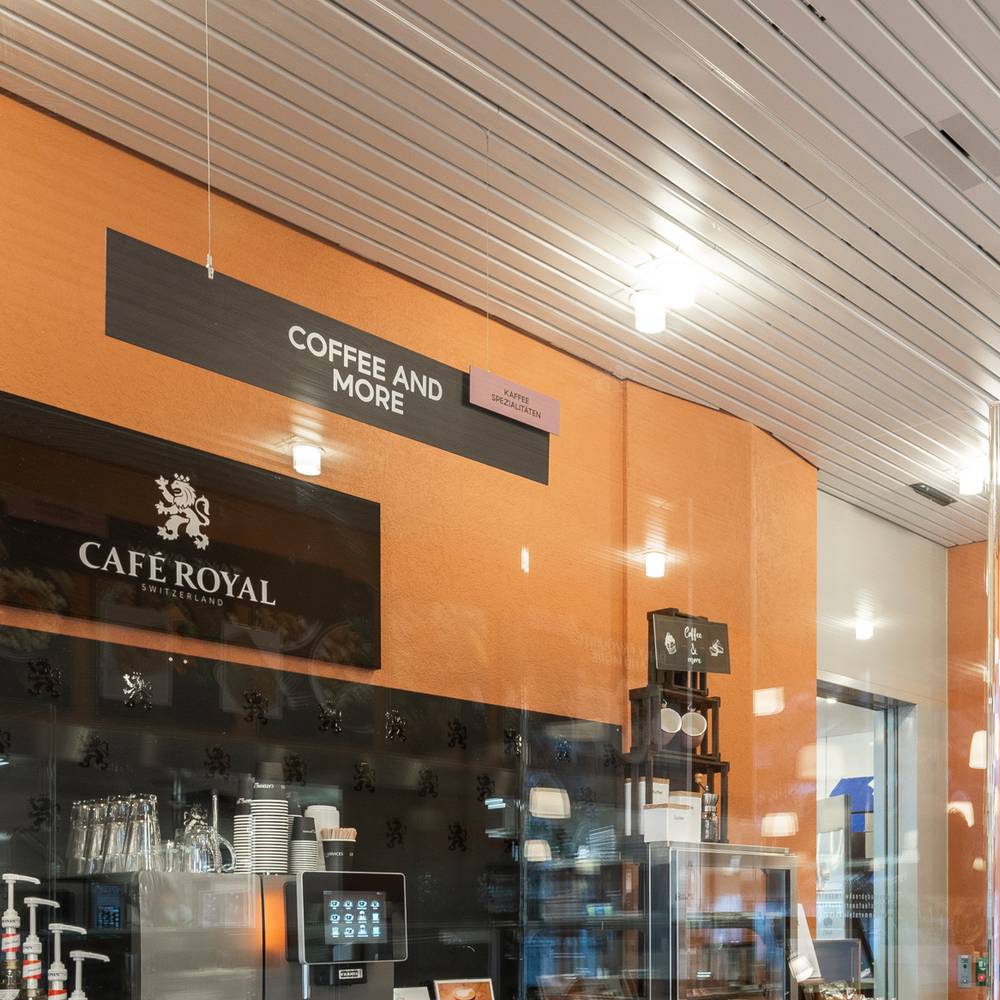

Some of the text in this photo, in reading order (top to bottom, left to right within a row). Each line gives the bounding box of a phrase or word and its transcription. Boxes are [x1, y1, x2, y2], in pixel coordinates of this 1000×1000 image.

[288, 325, 443, 401] COFFEE AND
[332, 368, 404, 415] MORE
[503, 388, 530, 405] KAFFEE
[491, 393, 542, 419] SPEZIALITÄTEN
[79, 541, 276, 606] CAFÉ ROYAL
[141, 583, 224, 606] SWITZERLAND
[684, 626, 703, 641] Coffee
[690, 642, 698, 655] &
[687, 657, 702, 665] more
